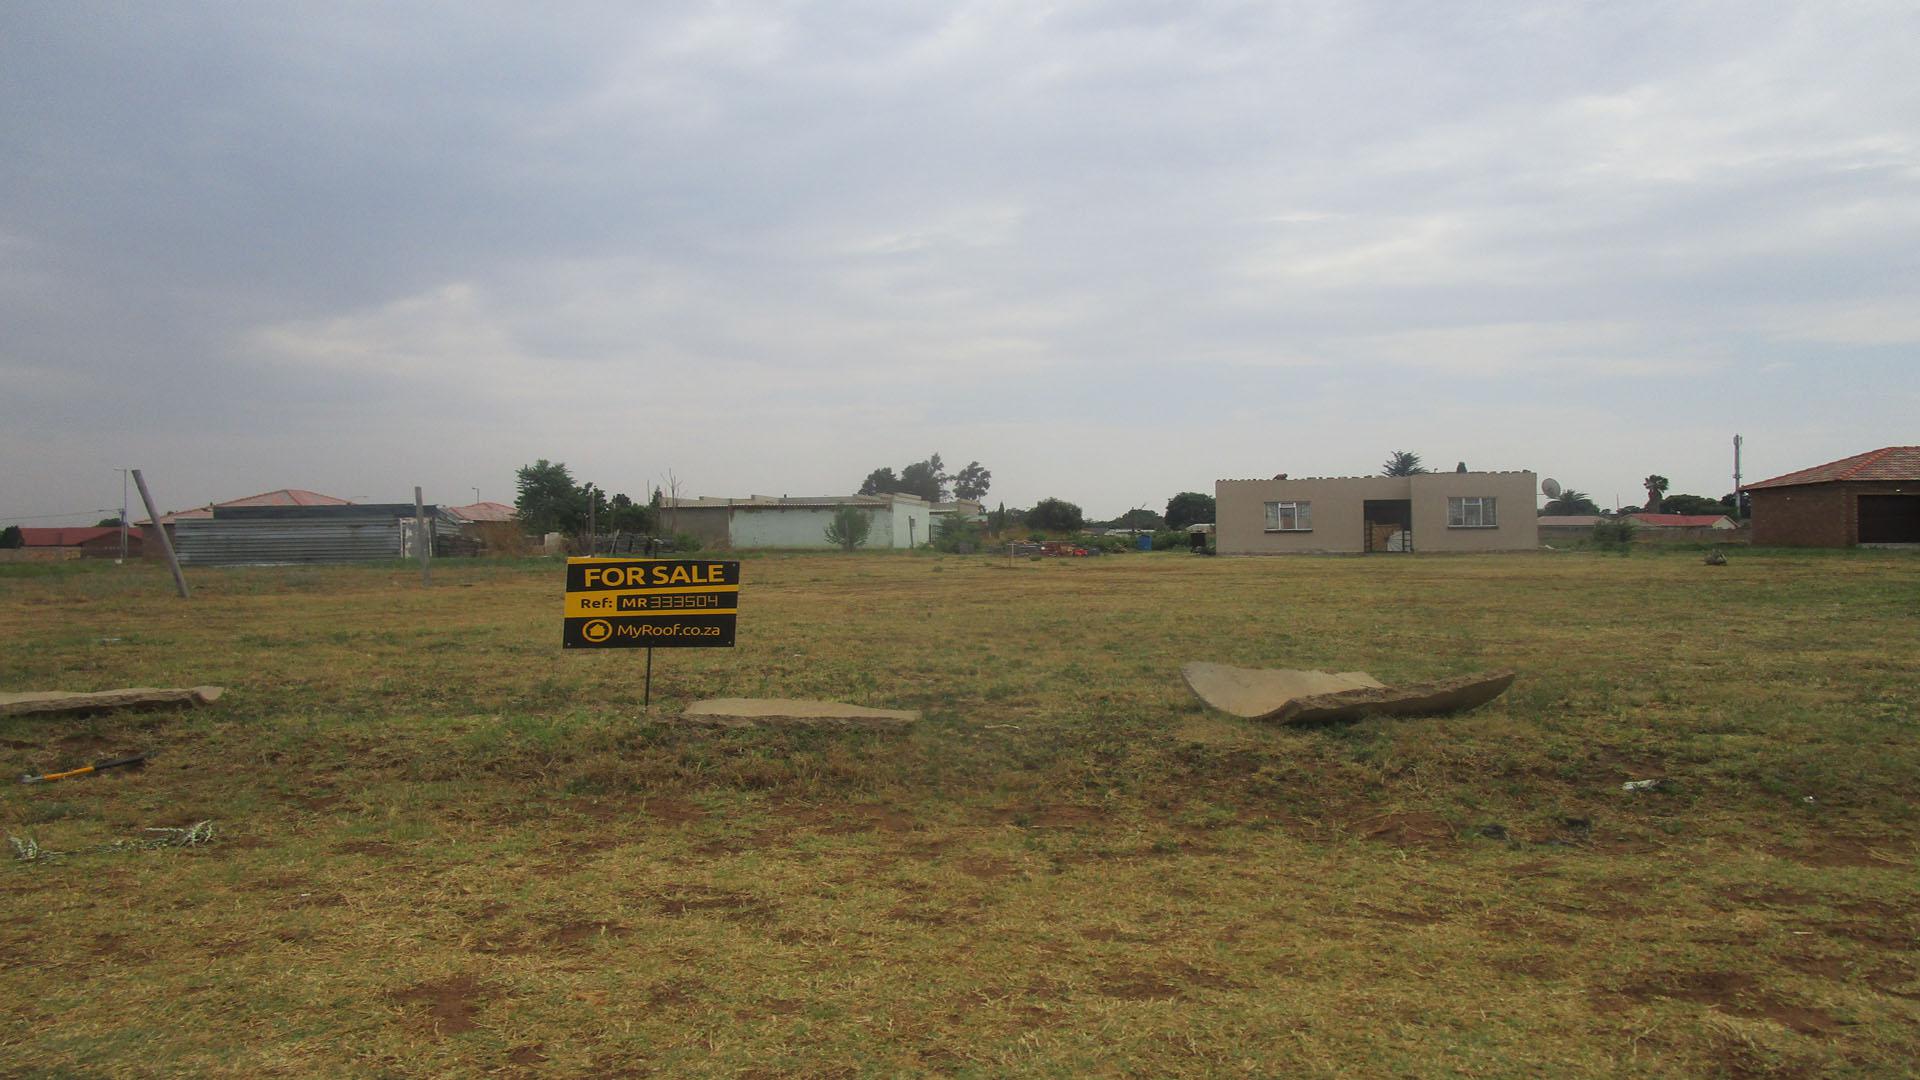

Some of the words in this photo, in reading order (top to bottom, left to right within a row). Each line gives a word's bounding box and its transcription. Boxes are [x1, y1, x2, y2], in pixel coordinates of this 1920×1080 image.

[584, 566, 646, 588] FOR
[652, 564, 725, 585] SALE
[580, 597, 613, 609] Ref:
[622, 598, 648, 608] MR
[650, 595, 719, 608] 333504
[617, 623, 721, 640] MyRoof.co.za
